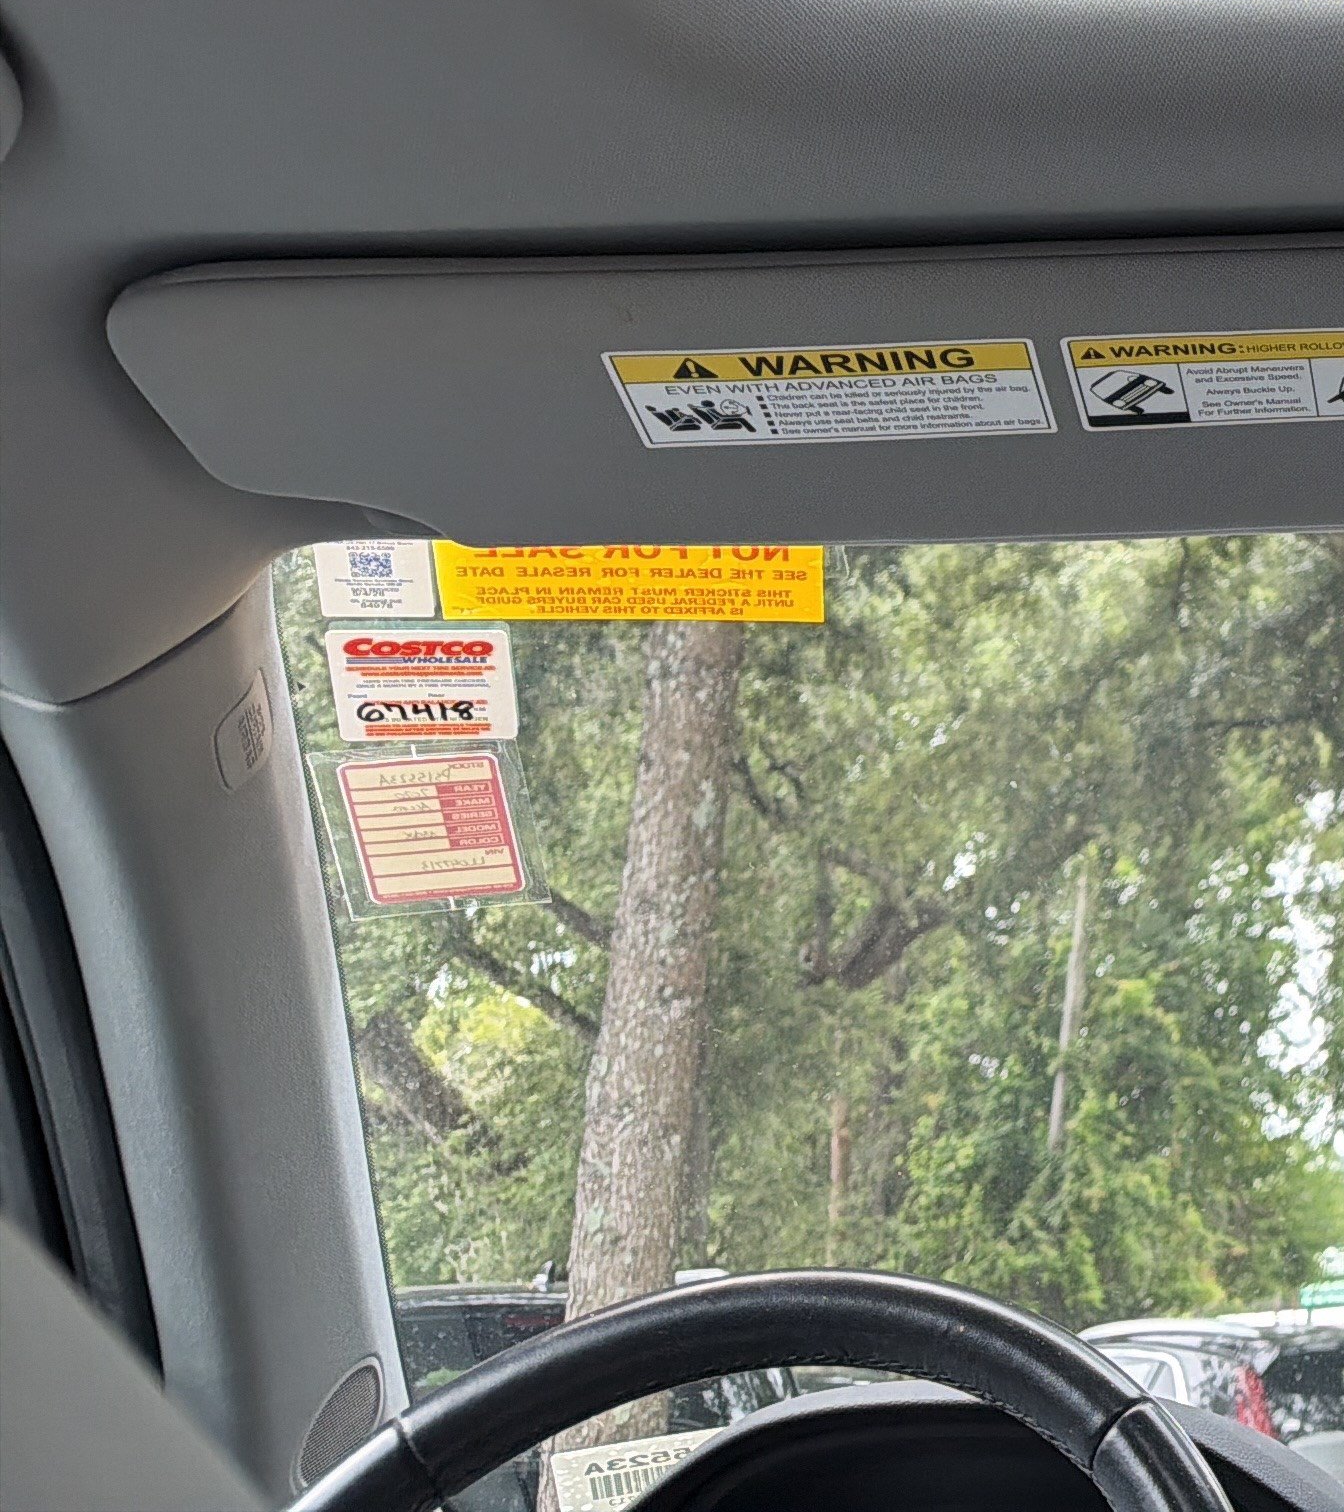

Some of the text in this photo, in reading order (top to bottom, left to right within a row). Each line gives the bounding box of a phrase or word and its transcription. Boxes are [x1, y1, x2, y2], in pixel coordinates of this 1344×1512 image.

[1247, 343, 1296, 353] HIGHER
[738, 348, 975, 377] WARNING
[1186, 367, 1213, 375] Avoid
[1215, 366, 1248, 375] Abrupt
[1216, 375, 1265, 383] Excessive
[665, 373, 998, 396] EVEN WITH ADVANCED AIR BAGS
[1206, 388, 1241, 396] Always
[1243, 386, 1276, 394] Buckle
[343, 638, 494, 656] COSTCO
[402, 656, 488, 664] WHOLESALE
[357, 700, 474, 722] 67418
